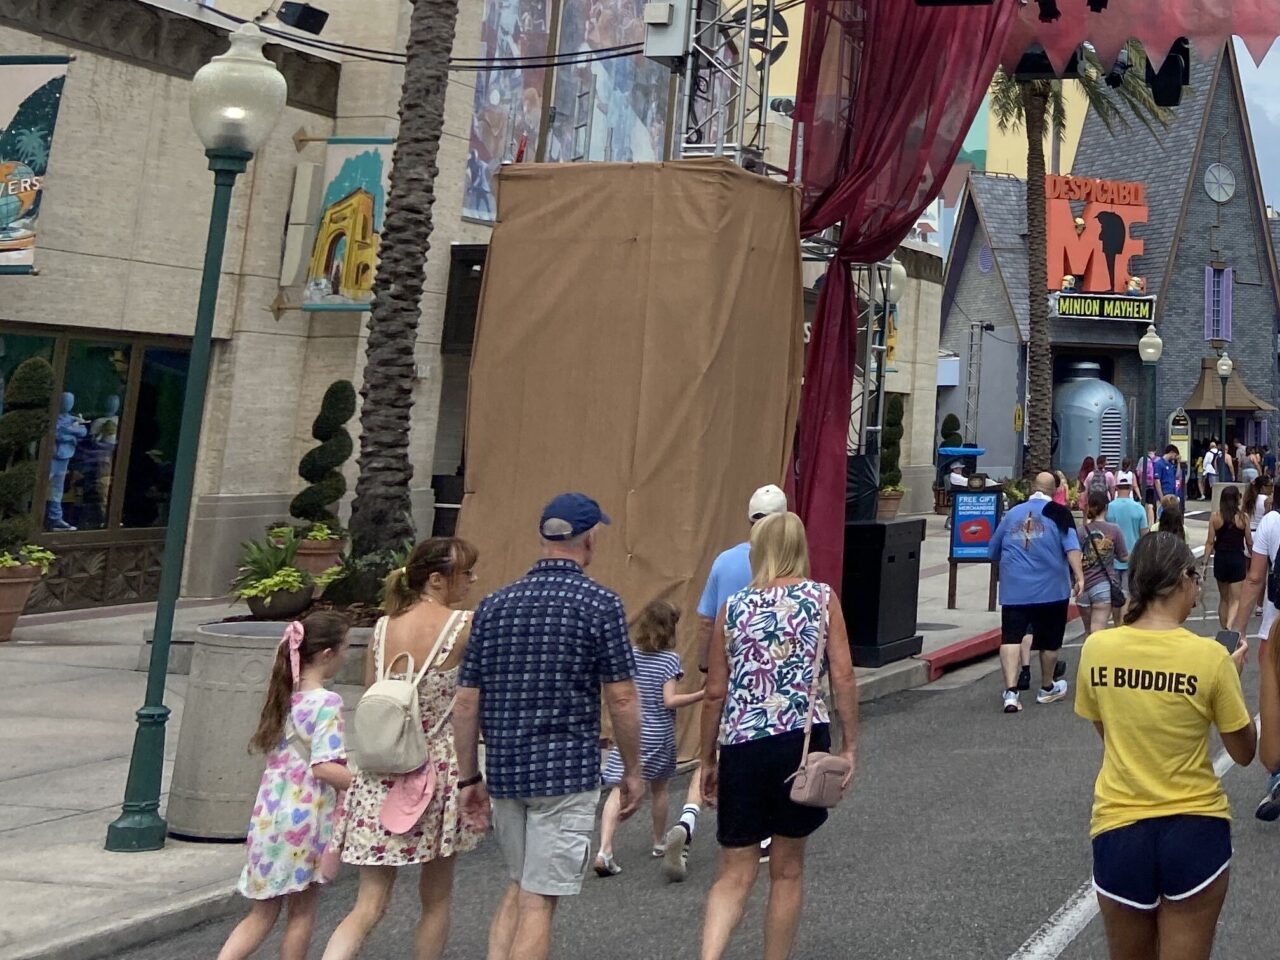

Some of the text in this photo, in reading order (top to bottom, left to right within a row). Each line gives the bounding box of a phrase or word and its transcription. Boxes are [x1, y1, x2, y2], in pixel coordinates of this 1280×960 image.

[1059, 297, 1150, 318] MINION MAYHEM
[959, 495, 996, 503] FREE GIFT
[1090, 666, 1198, 696] LE BUDDIES
